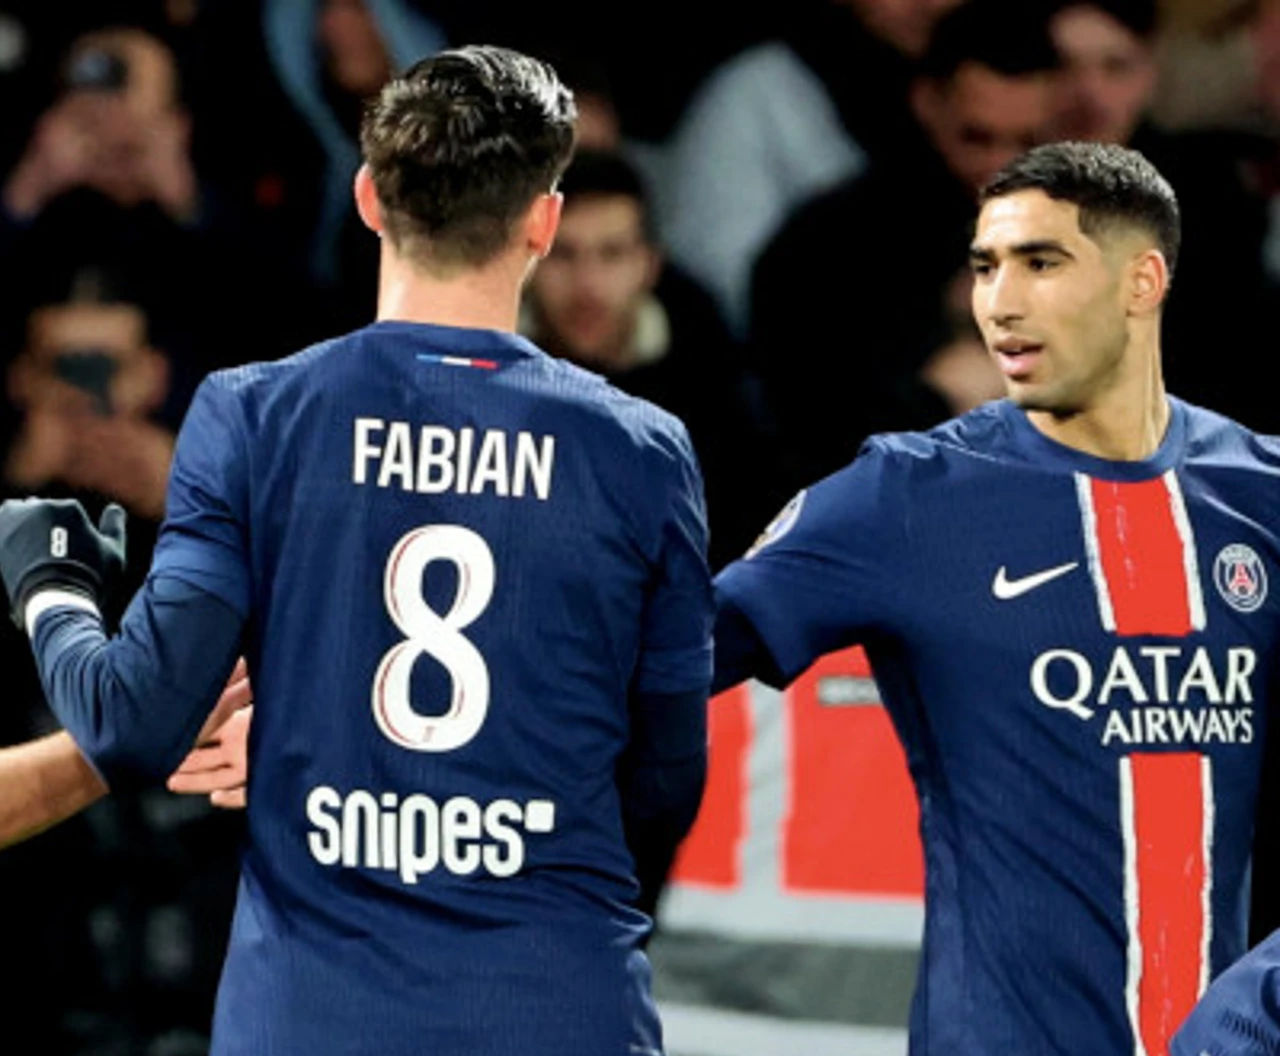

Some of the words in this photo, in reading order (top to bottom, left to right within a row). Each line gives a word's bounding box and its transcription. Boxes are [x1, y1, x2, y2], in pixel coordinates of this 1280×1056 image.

[352, 418, 554, 500] FABIAN
[50, 526, 68, 558] 8
[371, 523, 496, 752] 8
[1030, 645, 1257, 720] QATAR
[1100, 707, 1253, 746] AIRWAYS
